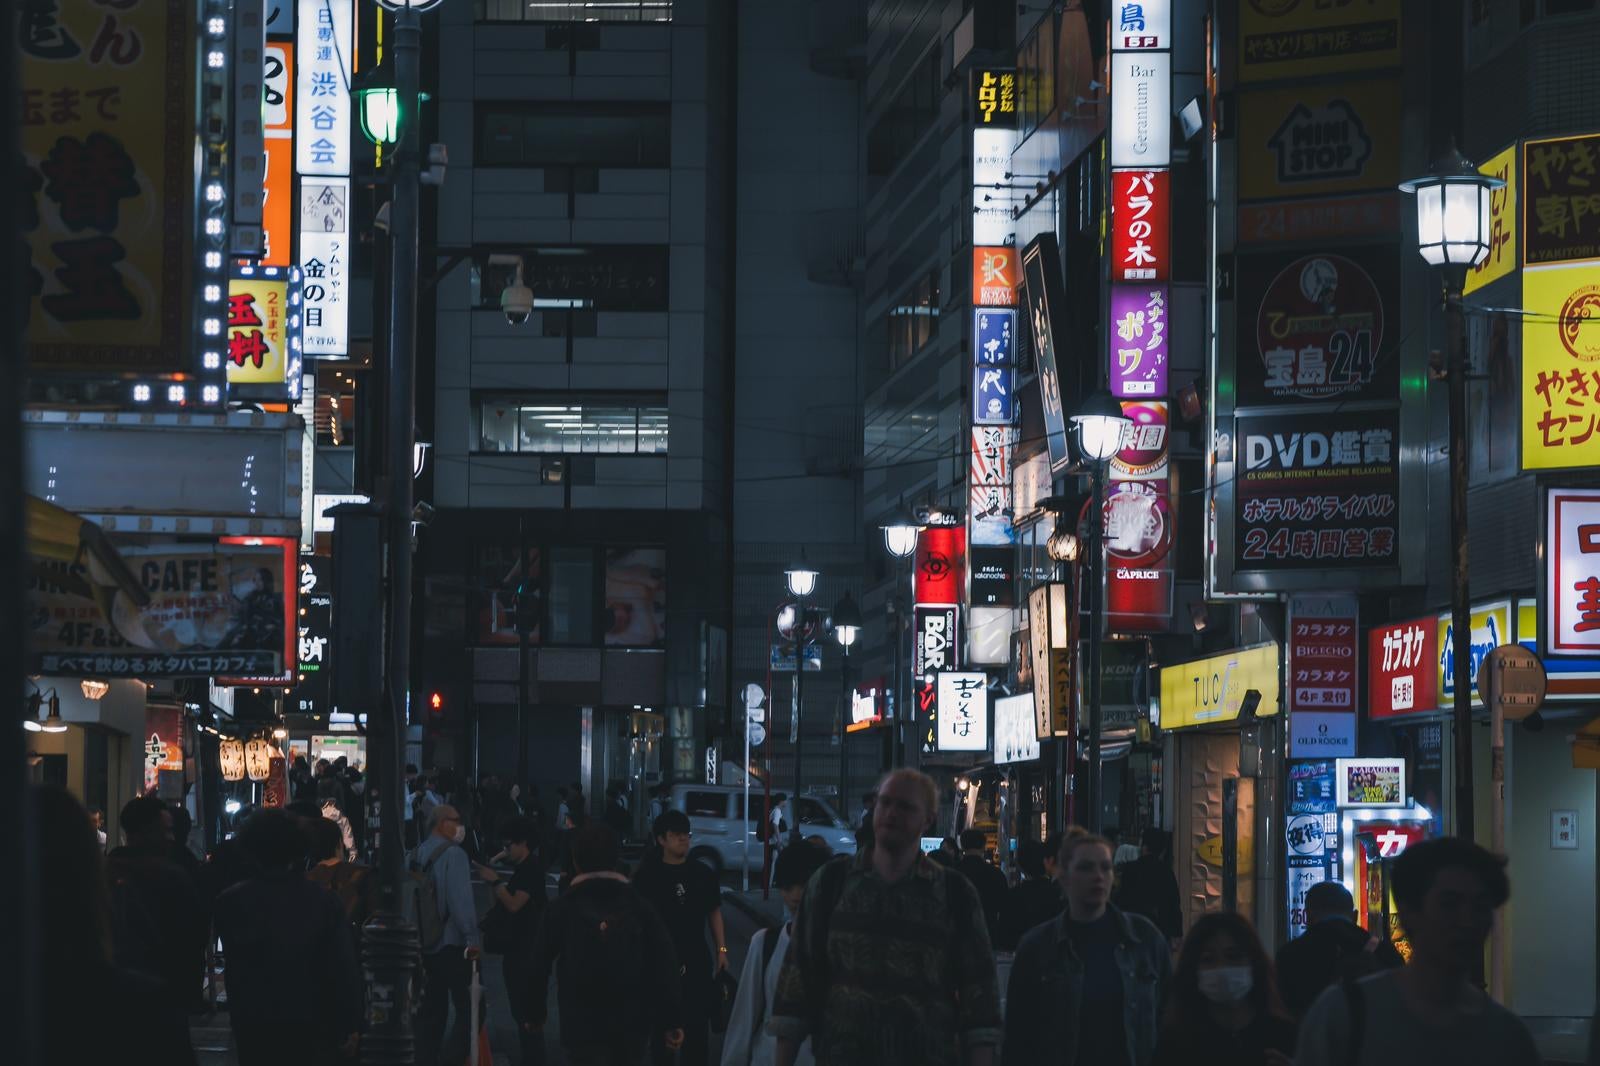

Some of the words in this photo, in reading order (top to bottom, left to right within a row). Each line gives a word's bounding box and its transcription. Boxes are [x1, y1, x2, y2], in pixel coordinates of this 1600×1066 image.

[317, 9, 332, 61] 日専連
[1131, 65, 1156, 77] Bar
[311, 71, 337, 164] 渋谷会
[1133, 82, 1148, 154] Geranium
[1292, 121, 1349, 146] MINI
[1290, 145, 1353, 172] STOP
[1124, 172, 1157, 267] バラの木
[1538, 246, 1595, 258] YAKITORI
[303, 258, 326, 328] 金の目
[1146, 290, 1165, 352] スナック
[1117, 310, 1145, 376] ポワ
[1537, 410, 1600, 447] セン
[1258, 470, 1283, 480] COMICS
[1284, 469, 1315, 478] INTERNET
[1317, 468, 1351, 478] MAGAZINE
[1352, 467, 1392, 476] RELAXATION
[1243, 494, 1395, 523] ホテルがライバル
[1243, 527, 1395, 560] 24時間営業
[141, 559, 218, 592] CAFE
[1116, 570, 1160, 580] CAPRICE
[924, 615, 946, 670] BAR
[1296, 623, 1352, 637] カラオケ
[1296, 646, 1318, 657] BIG
[1319, 645, 1353, 657] ECHO
[1382, 625, 1425, 672] カラオケ
[1296, 669, 1350, 683] カラオケ
[1299, 692, 1318, 703] 4F
[1321, 691, 1347, 704] 受付
[1393, 684, 1401, 700] 4F
[1401, 681, 1412, 703] 受付
[1298, 737, 1318, 746] OLD
[1319, 737, 1349, 746] ROOKIE
[1376, 830, 1408, 857] カ
